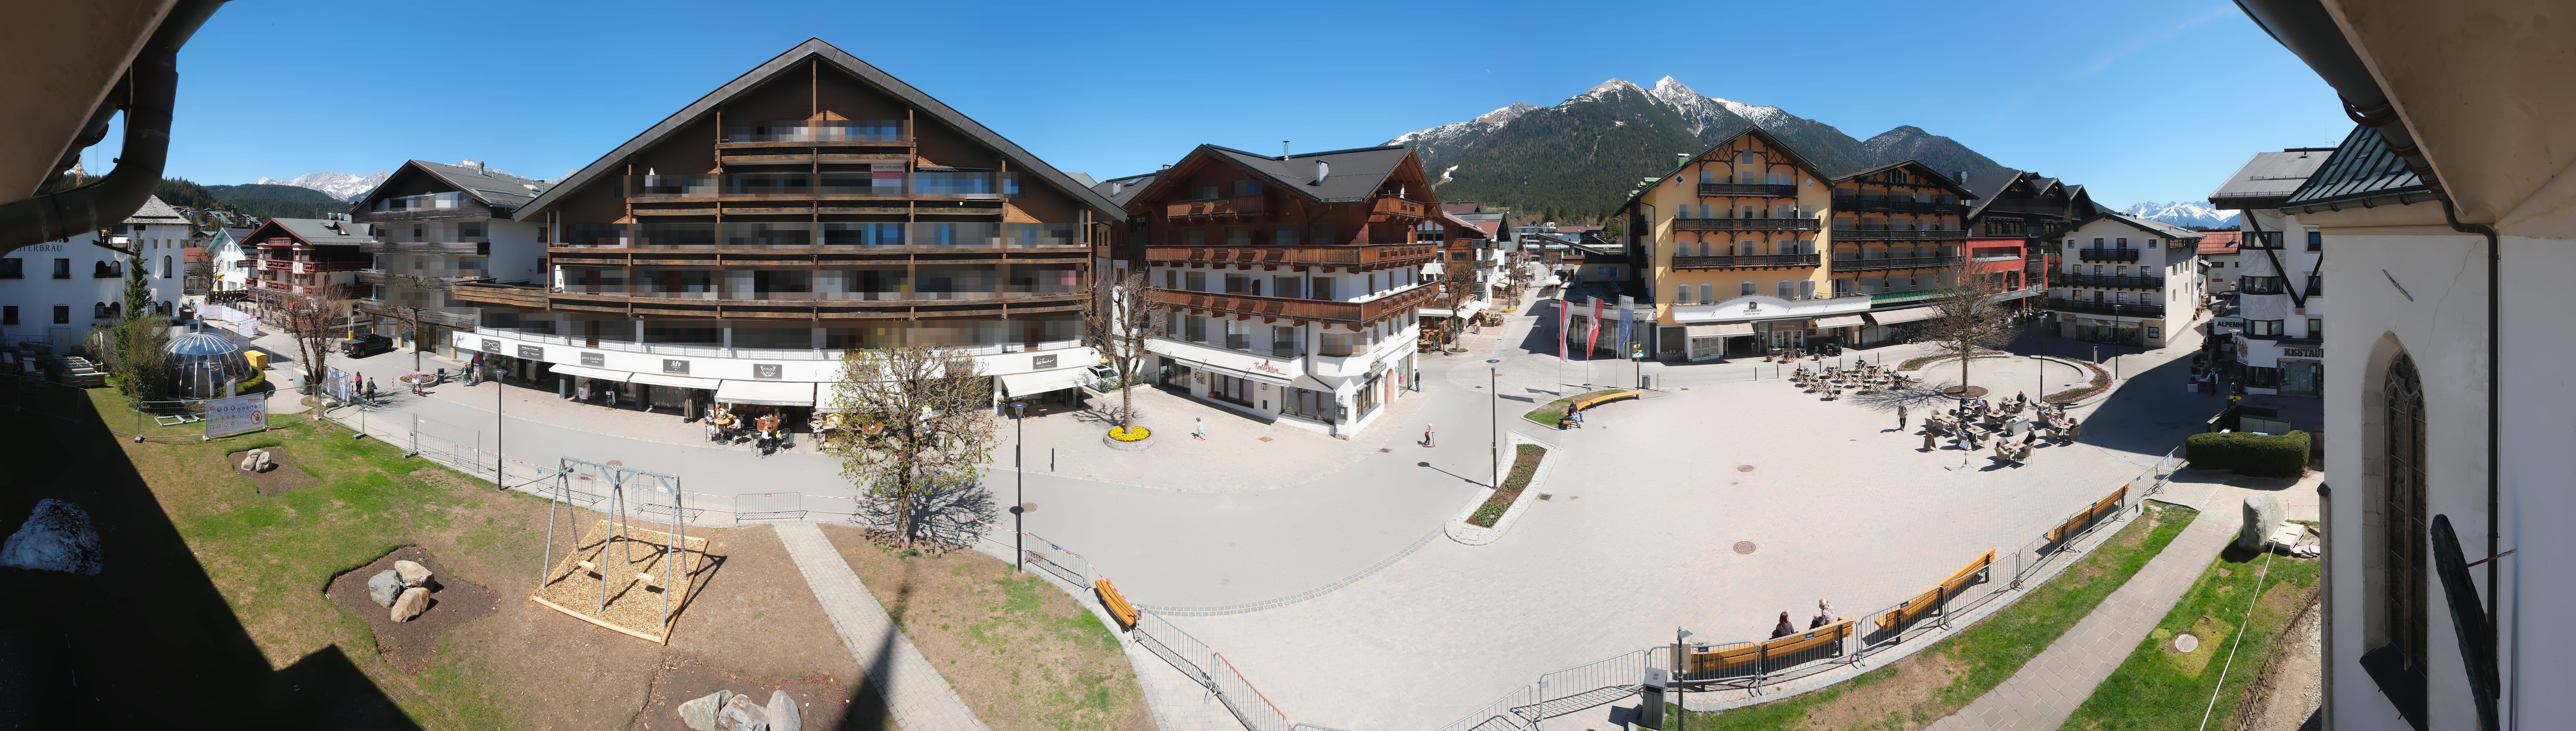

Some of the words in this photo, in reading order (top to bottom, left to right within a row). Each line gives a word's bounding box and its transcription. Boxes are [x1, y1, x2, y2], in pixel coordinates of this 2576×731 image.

[1402, 343, 1411, 352] SAILER
[671, 361, 682, 370] My
[1372, 364, 1386, 377] RESTAURANT
